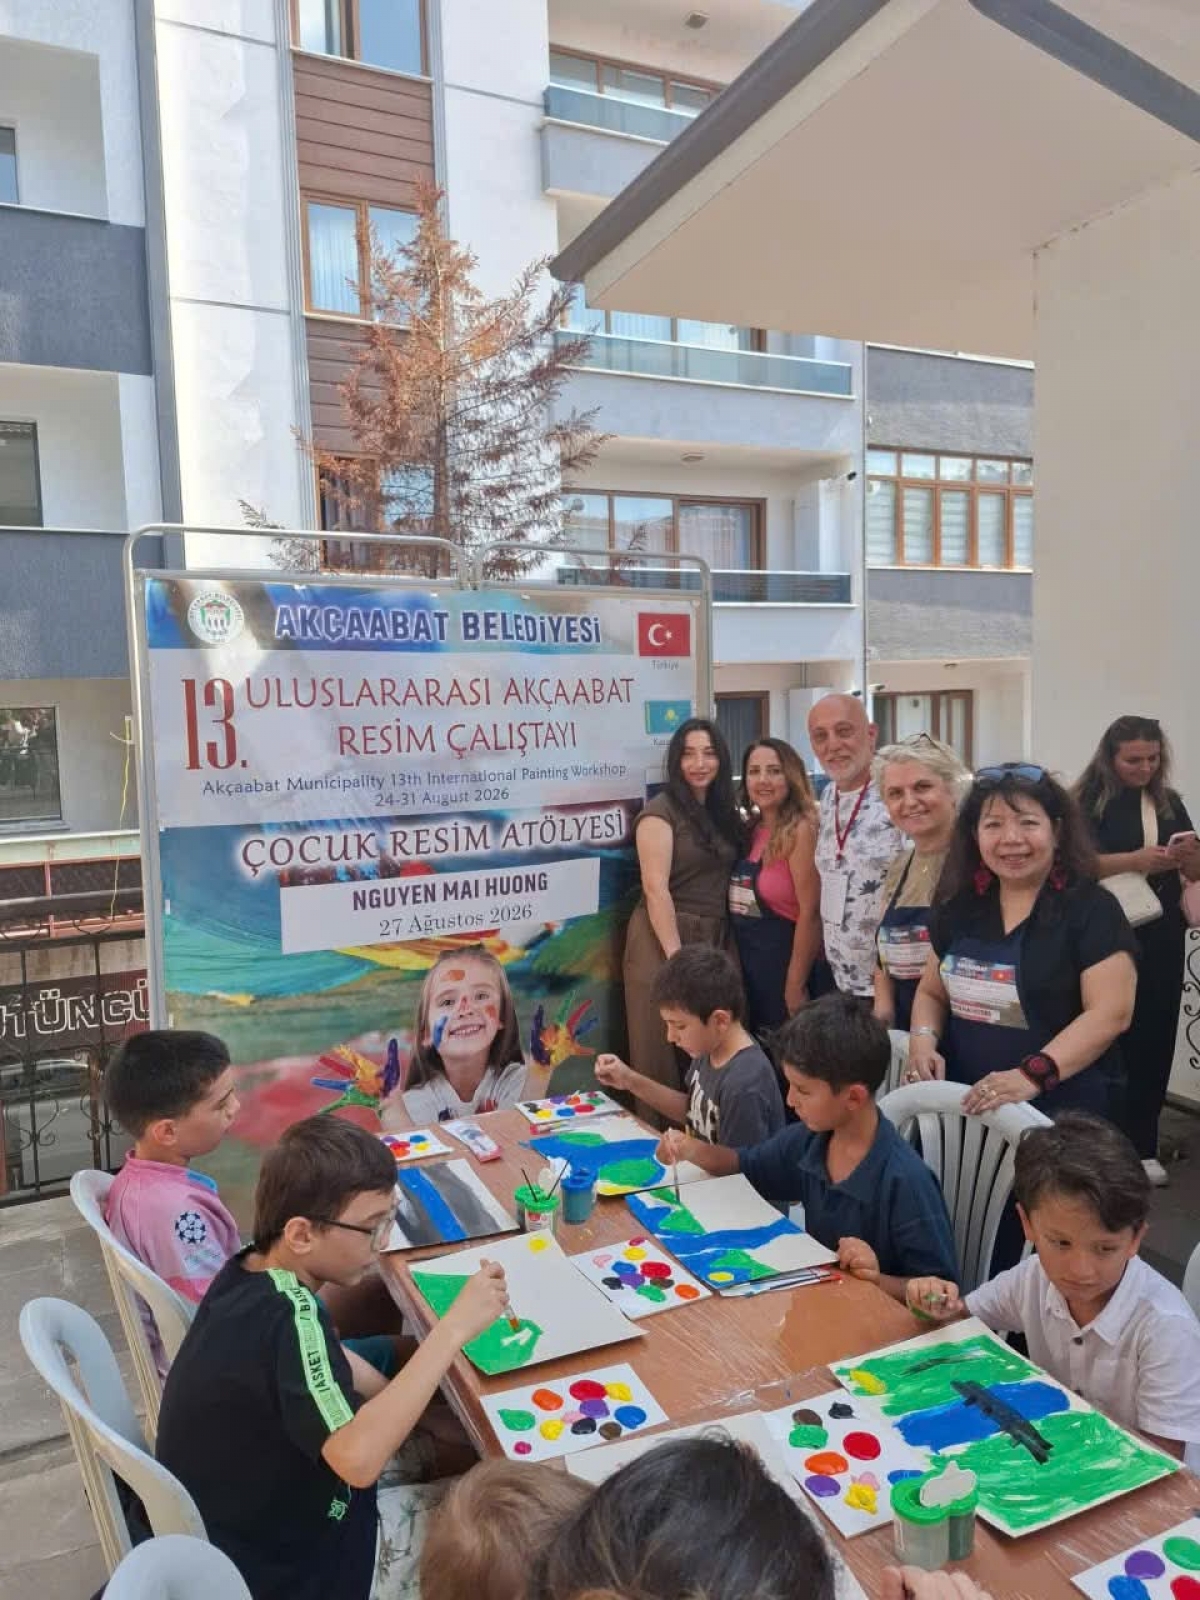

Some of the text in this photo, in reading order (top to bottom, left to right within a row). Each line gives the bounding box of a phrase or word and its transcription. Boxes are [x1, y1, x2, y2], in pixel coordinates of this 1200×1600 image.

[274, 604, 450, 641] AKÇAABAT
[181, 676, 635, 770] 13. ULUSLARARASI AKÇAABAT
[338, 717, 577, 760] RESİM ÇALIŞTAYI
[202, 763, 627, 797] Akçaabat Municipality 13th International Painting Workshop
[374, 788, 510, 807] 24-31 August 2026
[241, 808, 623, 878] ÇOCUK RESİM ATÖLYESİ
[352, 872, 548, 911] NGUYEN MAI HUONG
[379, 903, 533, 937] 27 Ağustos 2026
